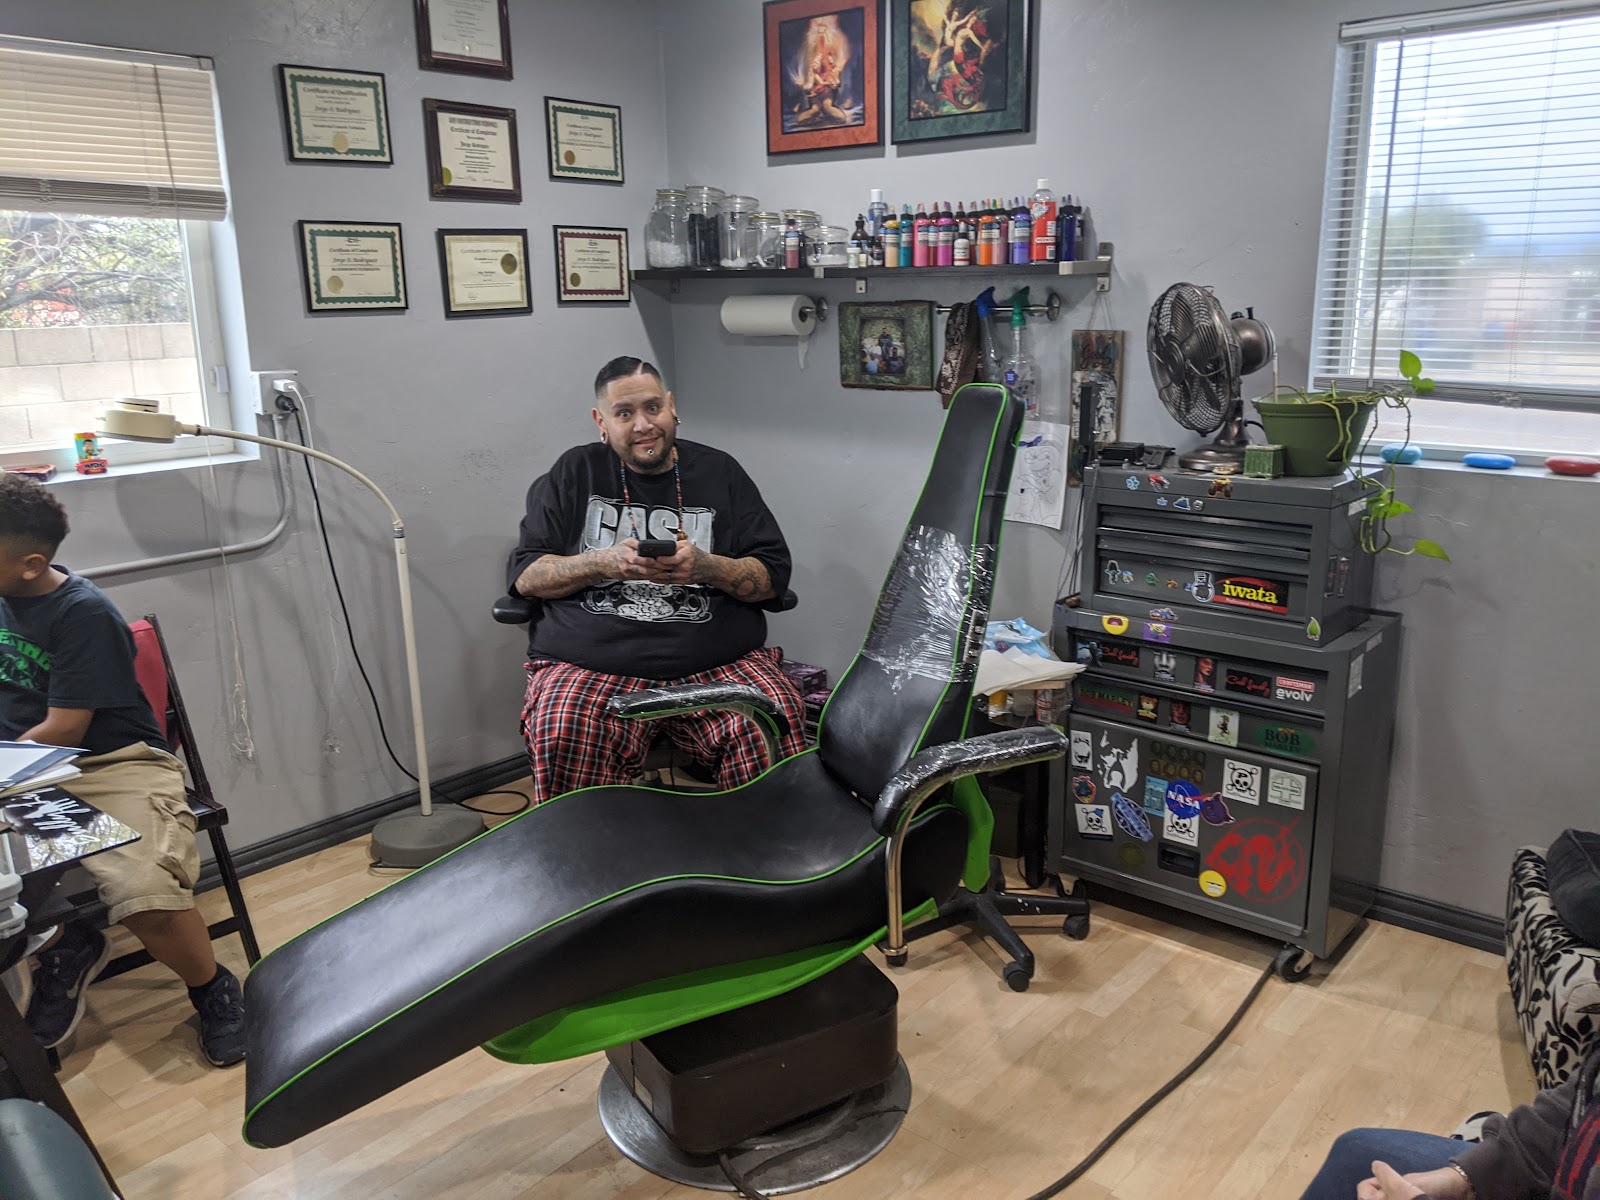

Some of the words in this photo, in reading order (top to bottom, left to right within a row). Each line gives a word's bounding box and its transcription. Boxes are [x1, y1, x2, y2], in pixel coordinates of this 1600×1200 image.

[583, 499, 715, 553] CASH
[1223, 580, 1278, 604] iwata
[1276, 688, 1313, 702] evolv
[1264, 729, 1300, 745] BOB
[1167, 790, 1200, 810] NASA
